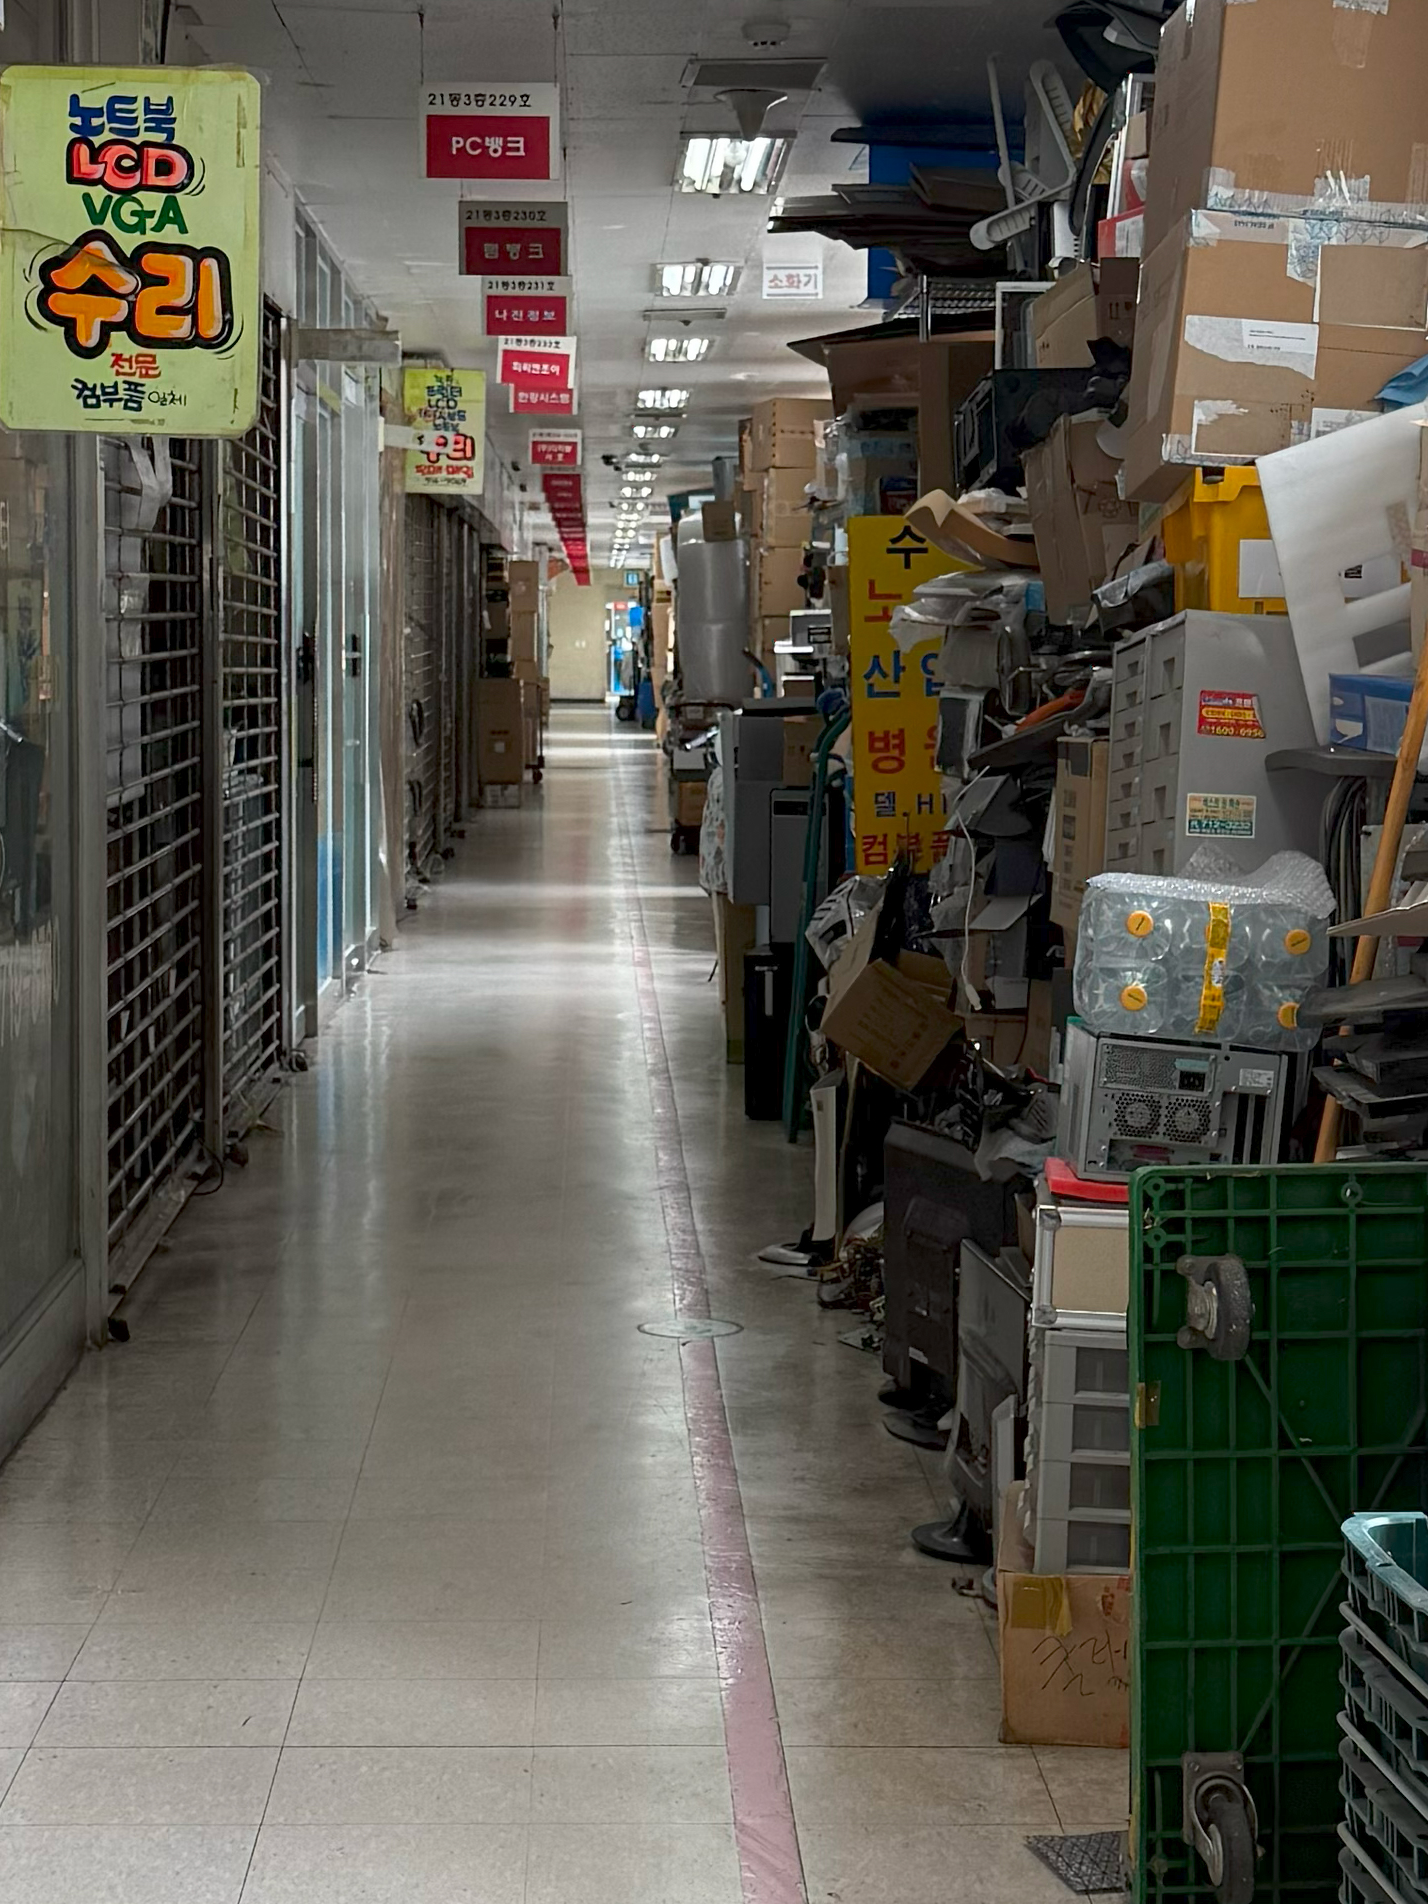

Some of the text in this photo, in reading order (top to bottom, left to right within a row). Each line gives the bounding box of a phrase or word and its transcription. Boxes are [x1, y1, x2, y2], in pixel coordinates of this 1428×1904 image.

[67, 94, 178, 144] 노트북
[427, 91, 532, 110] 21동3층229호
[65, 137, 194, 195] LCD
[450, 135, 525, 159] PC뱅크
[81, 192, 189, 236] VGA
[38, 228, 233, 359] 수리
[109, 352, 162, 379] 전문
[70, 377, 188, 413] 컴부품 일체
